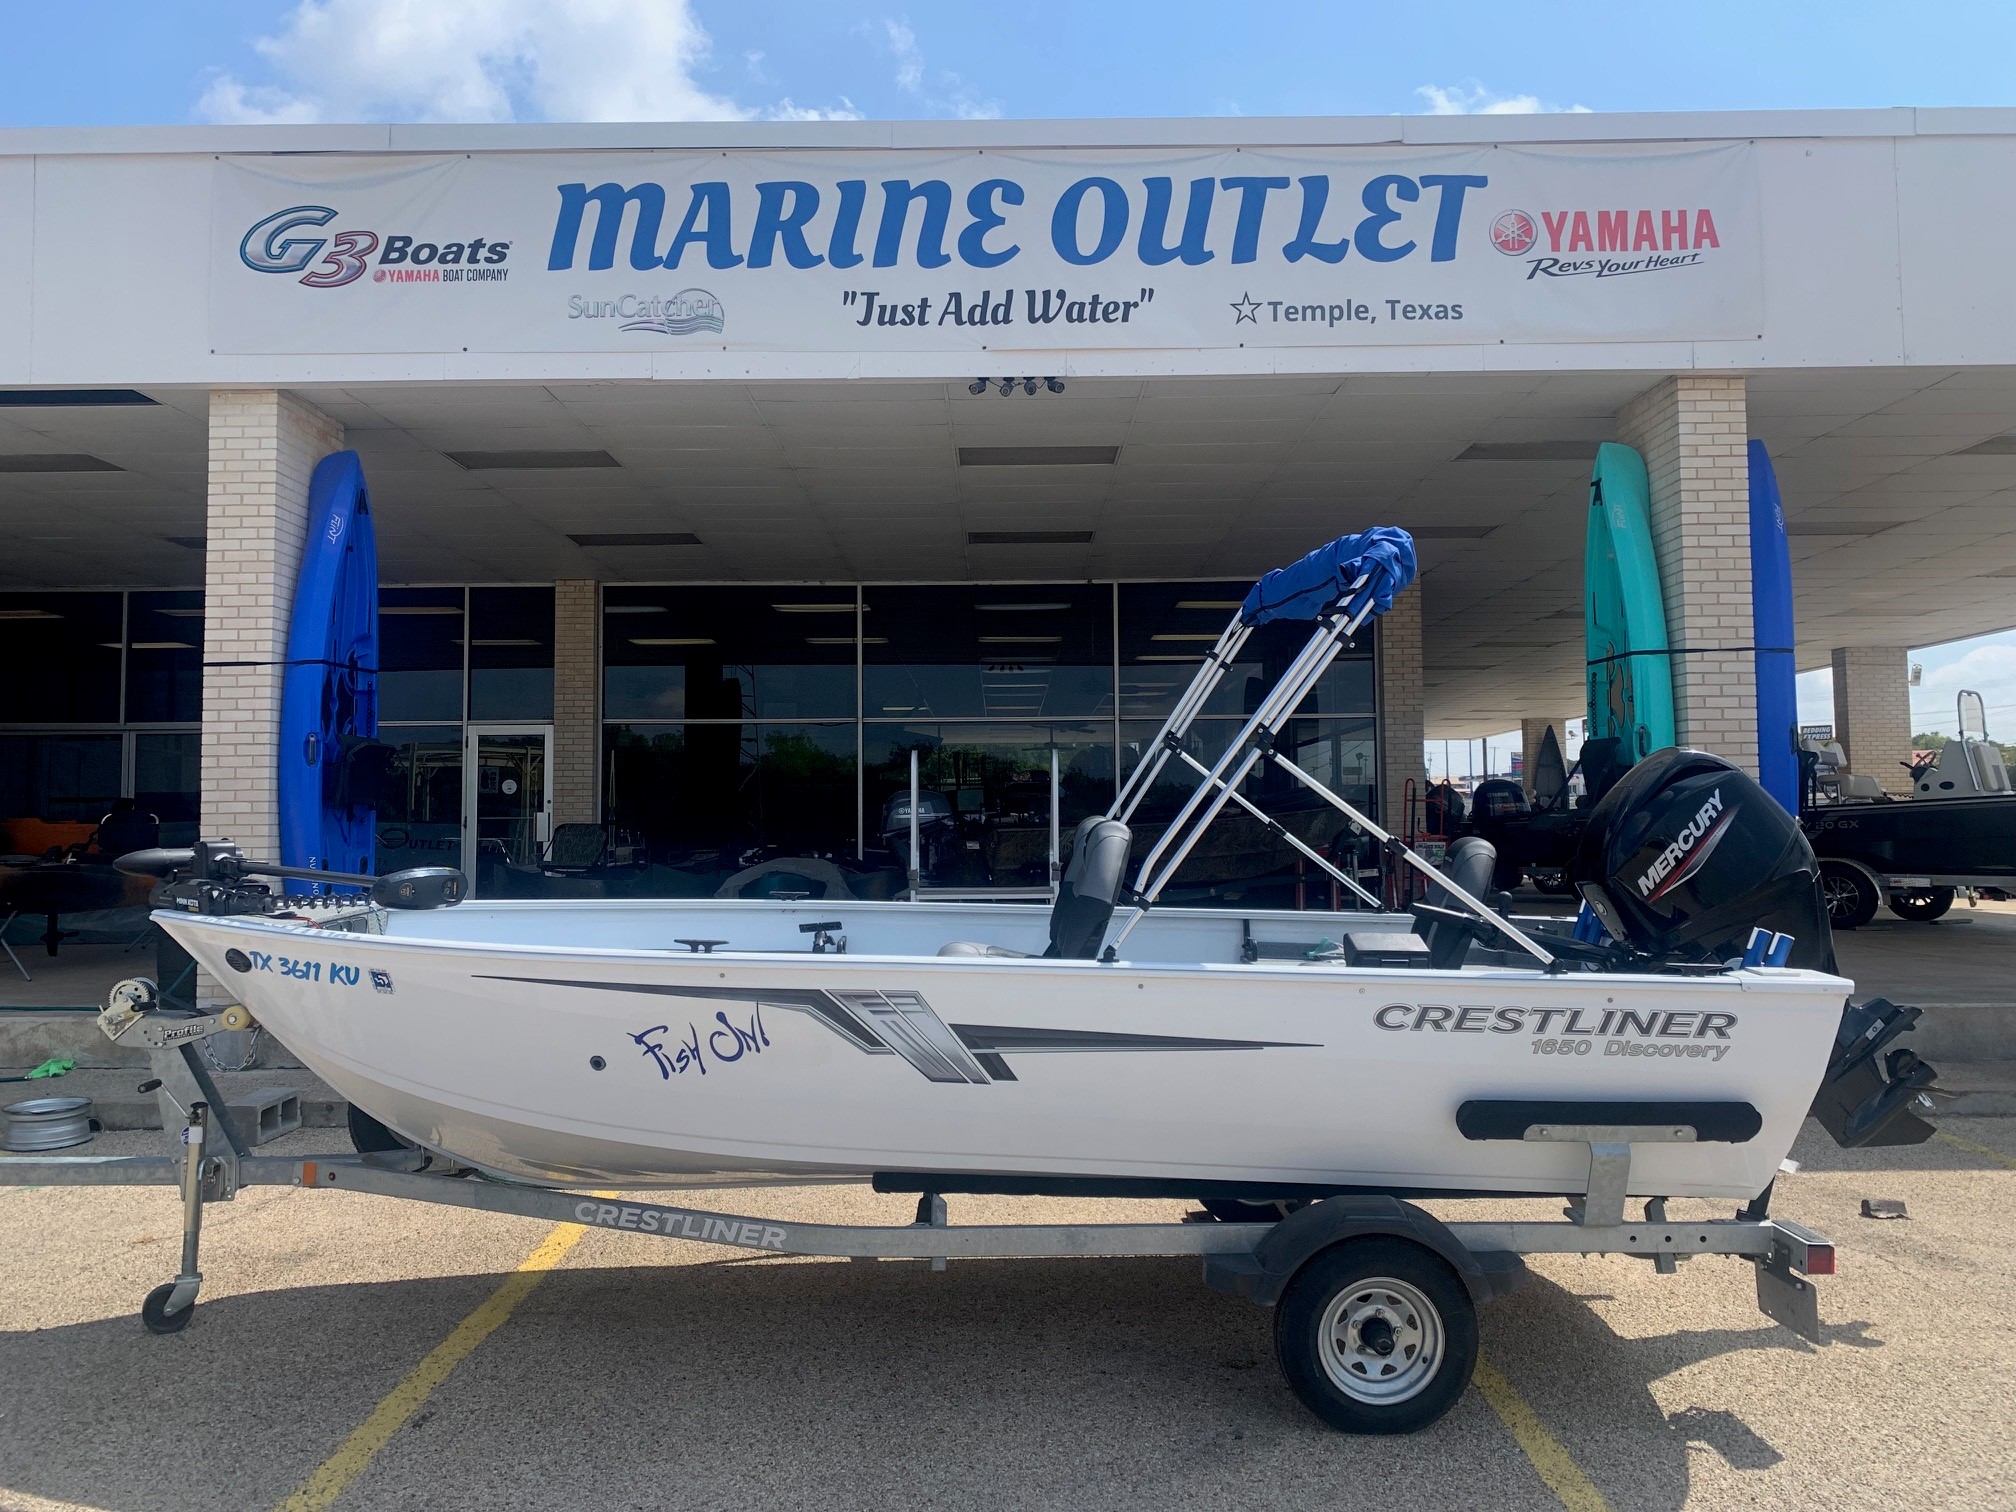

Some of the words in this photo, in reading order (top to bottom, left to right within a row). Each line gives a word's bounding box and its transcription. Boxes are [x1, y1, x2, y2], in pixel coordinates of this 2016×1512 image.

[547, 177, 1025, 271] MARINE
[1050, 174, 1488, 266] OUTLET
[1541, 208, 1720, 253] YAMAHA
[239, 205, 379, 289] G3
[388, 269, 440, 283] YAMAHA
[442, 269, 464, 283] BOAT
[466, 268, 509, 282] COMPANY
[1526, 257, 1594, 280] Revs
[1596, 257, 1646, 278] Your
[1645, 252, 1702, 270] Heart
[567, 293, 720, 319] SunCatcher
[937, 290, 1013, 326] Add
[1268, 299, 1377, 326] Temple,
[1385, 298, 1463, 321] Texas
[1803, 726, 1831, 734] BEDDING
[1637, 788, 1724, 897] MERCURY
[249, 951, 274, 972] TX
[330, 962, 360, 986] KU
[163, 1024, 204, 1040] Profile
[1372, 1003, 1738, 1039] CRESTLINER
[1530, 1039, 1592, 1056] 1650
[1604, 1040, 1730, 1062] Discovery
[574, 1201, 788, 1249] CRESTLINER
